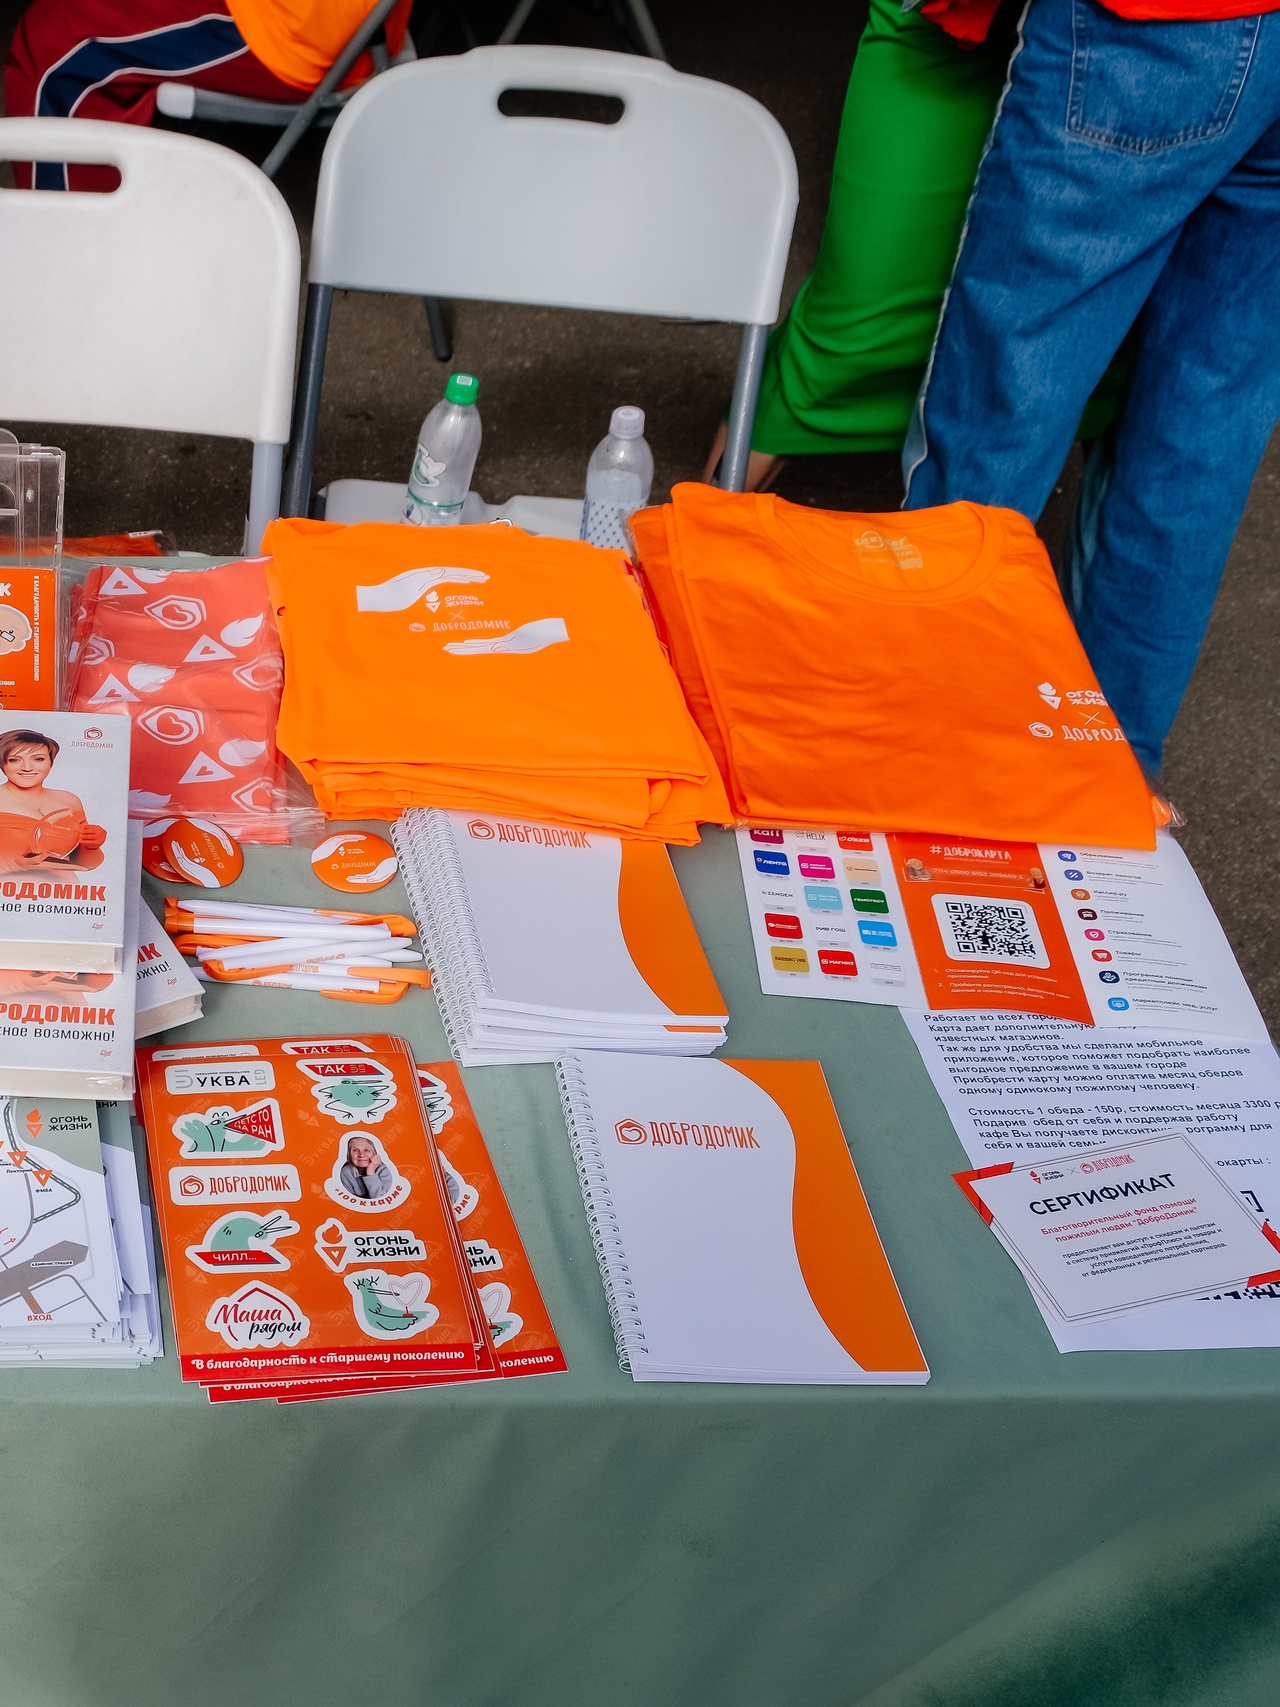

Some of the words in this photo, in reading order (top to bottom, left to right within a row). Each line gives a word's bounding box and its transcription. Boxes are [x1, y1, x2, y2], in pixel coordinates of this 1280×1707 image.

[433, 620, 510, 632] ДОБРОДОМИК
[1065, 690, 1106, 699] ОГОН
[1068, 698, 1109, 707] ЖИЗ
[1061, 725, 1128, 743] ДОБРОД
[71, 740, 115, 749] ДОБРОДОМИК
[497, 822, 592, 849] ДОБРОДОМИК
[930, 845, 1012, 860] #ДОБРОКАРТА
[27, 903, 107, 917] возможно!
[924, 1014, 976, 1022] Работает
[34, 1028, 115, 1042] возможно!
[929, 1024, 962, 1033] Карта
[999, 1033, 1065, 1041] магазинов.
[300, 1046, 330, 1054] ТАК
[938, 1044, 959, 1052] Так
[979, 1045, 1001, 1053] для
[1004, 1043, 1059, 1053] удобства
[1084, 1042, 1134, 1050] сделали
[1136, 1038, 1204, 1047] мобильное
[944, 1055, 1020, 1064] приложение,
[1021, 1054, 1069, 1063] которое
[1072, 1052, 1123, 1060] поможет
[1126, 1049, 1191, 1060] подобрать
[1193, 1047, 1251, 1056] наиболее
[314, 1064, 346, 1073] ТАК
[948, 1066, 1006, 1074] выгодное
[1009, 1064, 1090, 1074] предложение
[1103, 1063, 1142, 1071] вашем
[1145, 1061, 1187, 1070] городе
[953, 1075, 1024, 1084] Приобрести
[1027, 1075, 1060, 1084] карту
[1063, 1074, 1103, 1082] можно
[1106, 1073, 1156, 1081] оплатив
[1158, 1071, 1197, 1080] месяц
[1198, 1068, 1244, 1078] обедов
[959, 1087, 1003, 1095] одному
[1006, 1085, 1071, 1095] одинокому
[1075, 1084, 1136, 1093] пожилому
[1139, 1082, 1200, 1091] человеку.
[968, 1107, 1034, 1116] Стоимость
[1037, 1106, 1044, 1115] 1
[1047, 1105, 1085, 1115] обеда
[1094, 1105, 1127, 1115] 150р,
[1129, 1104, 1194, 1113] стоимость
[1196, 1102, 1242, 1111] месяца
[1243, 1100, 1271, 1108] 3300
[48, 1122, 92, 1131] ЖИЗНИ
[50, 1115, 88, 1124] ОГОНЬ
[973, 1118, 1027, 1128] Подарив
[1033, 1117, 1063, 1126] обед
[1082, 1116, 1111, 1125] себя
[1125, 1115, 1193, 1124] поддержав
[1196, 1113, 1238, 1122] работу
[251, 1124, 273, 1140] РАН
[651, 1121, 761, 1150] ДОБРОДОМИК
[979, 1130, 1009, 1139] кафе
[1012, 1129, 1032, 1138] Вы
[1035, 1128, 1099, 1138] получаете
[1185, 1125, 1246, 1135] рограмму
[1250, 1123, 1273, 1131] для
[984, 1141, 1013, 1150] себя
[1026, 1140, 1066, 1148] вашей
[1091, 1154, 1135, 1172] ДОБРОДОМИК
[209, 1175, 291, 1195] ДОБРОДОМИК
[359, 1199, 367, 1207] к
[370, 1184, 403, 1208] карме
[1029, 1173, 1176, 1215] СЕРТИФИКАТ
[1040, 1210, 1133, 1236] Благотворительный
[1134, 1206, 1158, 1217] фонд
[1159, 1197, 1197, 1210] помощи
[1055, 1228, 1100, 1243] пожилым
[1101, 1221, 1133, 1234] людям
[1132, 1206, 1198, 1226] "ДоброДомик"
[354, 1236, 410, 1246] ОГОНЬ
[212, 1252, 257, 1261] ЧИЛЛ...
[356, 1246, 420, 1258] ЖИЗНИ
[1062, 1244, 1112, 1259] предоставляет
[1114, 1248, 1163, 1262] повседневного
[1143, 1251, 1190, 1265] региональных
[27, 1313, 53, 1322] ВХОД
[214, 1303, 282, 1325] Маша
[248, 1321, 302, 1341] рядом
[191, 1359, 205, 1369] В
[207, 1355, 307, 1369] благодарность
[309, 1355, 317, 1364] к
[319, 1351, 391, 1364] старшему
[393, 1350, 465, 1362] поколению
[500, 1354, 555, 1368] колению
